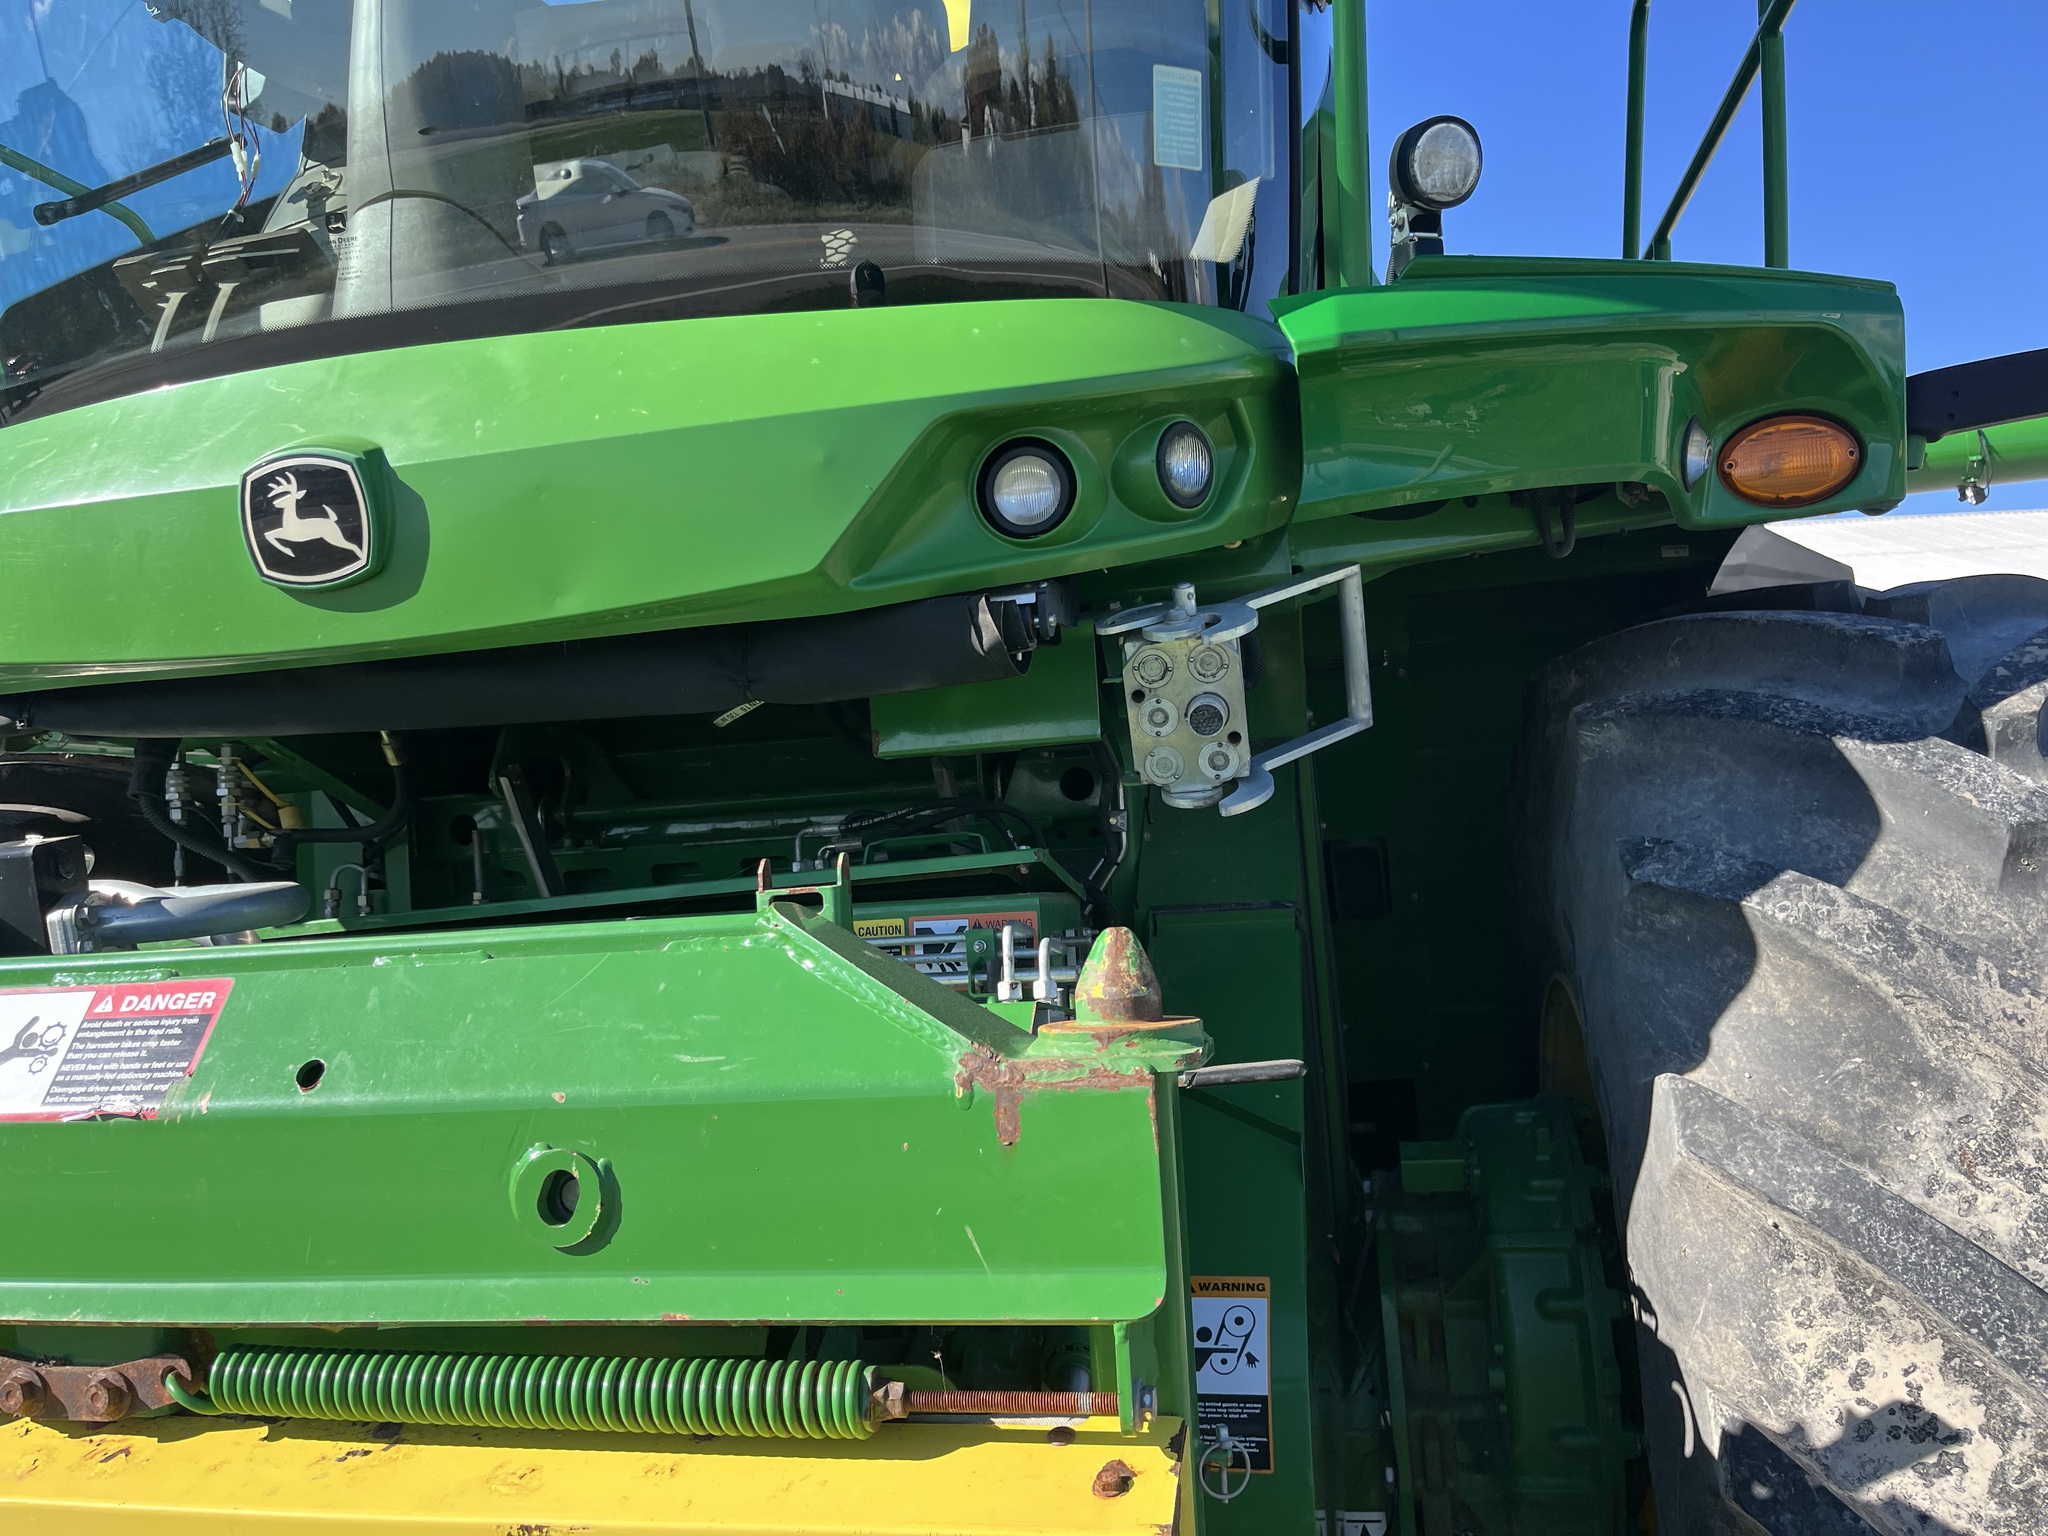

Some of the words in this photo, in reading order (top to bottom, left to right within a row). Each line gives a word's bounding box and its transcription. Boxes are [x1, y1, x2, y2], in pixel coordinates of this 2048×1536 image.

[986, 919, 1033, 928] WARNG
[858, 925, 901, 937] CAUTION
[120, 992, 216, 1012] DANGER
[160, 1018, 181, 1026] injury
[77, 1029, 125, 1038] entanglement
[142, 1041, 158, 1049] crop
[71, 1072, 116, 1081] manually-fed
[117, 1072, 152, 1080] stationary
[50, 1086, 86, 1094] Disengage
[125, 1083, 142, 1091] shut
[154, 1083, 171, 1091] engi
[69, 1094, 102, 1103] manually
[1198, 1282, 1266, 1292] WARNING
